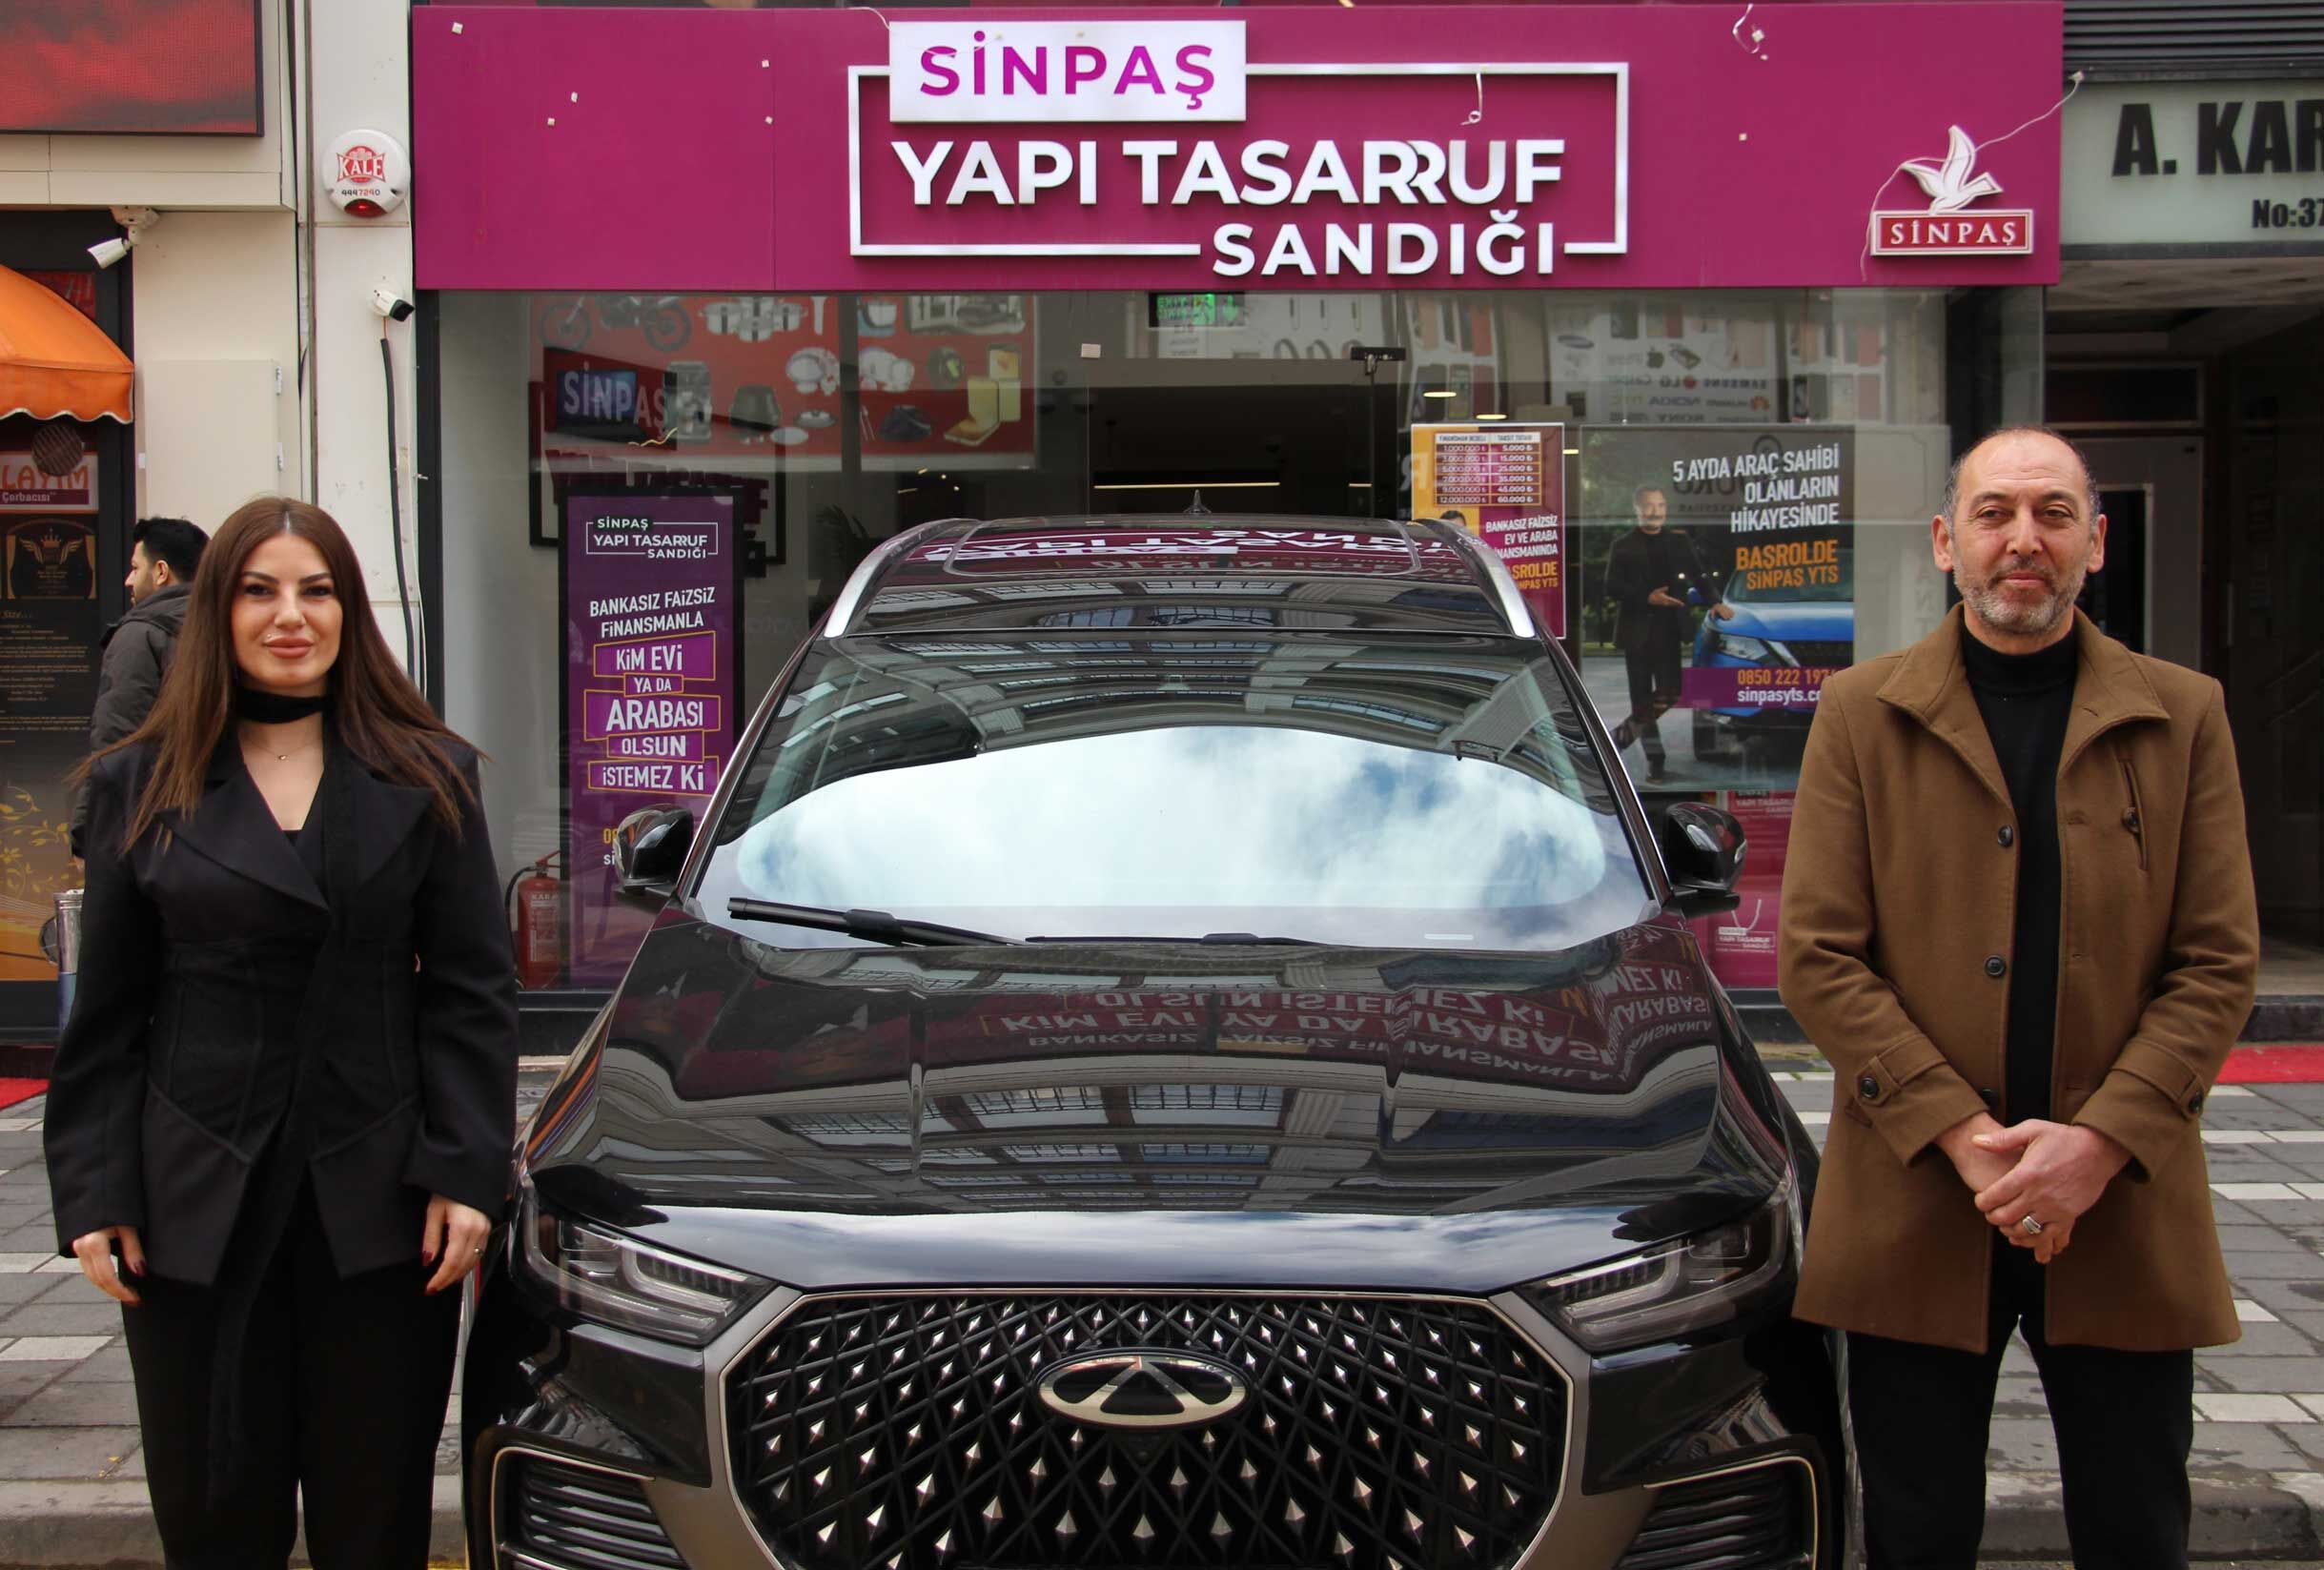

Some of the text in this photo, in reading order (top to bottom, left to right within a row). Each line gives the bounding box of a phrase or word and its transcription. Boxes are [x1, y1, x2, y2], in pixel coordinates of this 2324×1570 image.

[920, 30, 1215, 111] SİNPAŞ
[2111, 103, 2178, 176] A.
[338, 155, 383, 179] KALE
[890, 138, 1565, 206] YAPI TASARRUF
[1212, 209, 1554, 277] SANDIĞI
[1890, 219, 2017, 246] SİNPAŞ
[1673, 443, 1840, 482] 5 AYDA ARAÇ SAHİBİ
[1744, 475, 1839, 503] OLANLARIN
[597, 516, 649, 531] SİNPAŞ
[1485, 514, 1558, 533] BANKASIZ FAİZSİZ
[1730, 501, 1840, 533] HİKAYESİNDE
[594, 535, 707, 546] YAPI TASARRUF
[1504, 529, 1559, 545] EV VE ARABA
[647, 546, 705, 559] SANDIĞI
[1736, 540, 1838, 570] BAŞROLDE
[1541, 577, 1559, 588] YTS
[1807, 564, 1839, 585] YTS
[589, 593, 661, 617] BANKASIZ
[601, 610, 703, 639] FİNANSMANLA
[634, 677, 671, 693] YA DA
[1738, 668, 1837, 684] 0850 222 197
[605, 699, 703, 732] ARABASI
[621, 735, 686, 757] OLSUN
